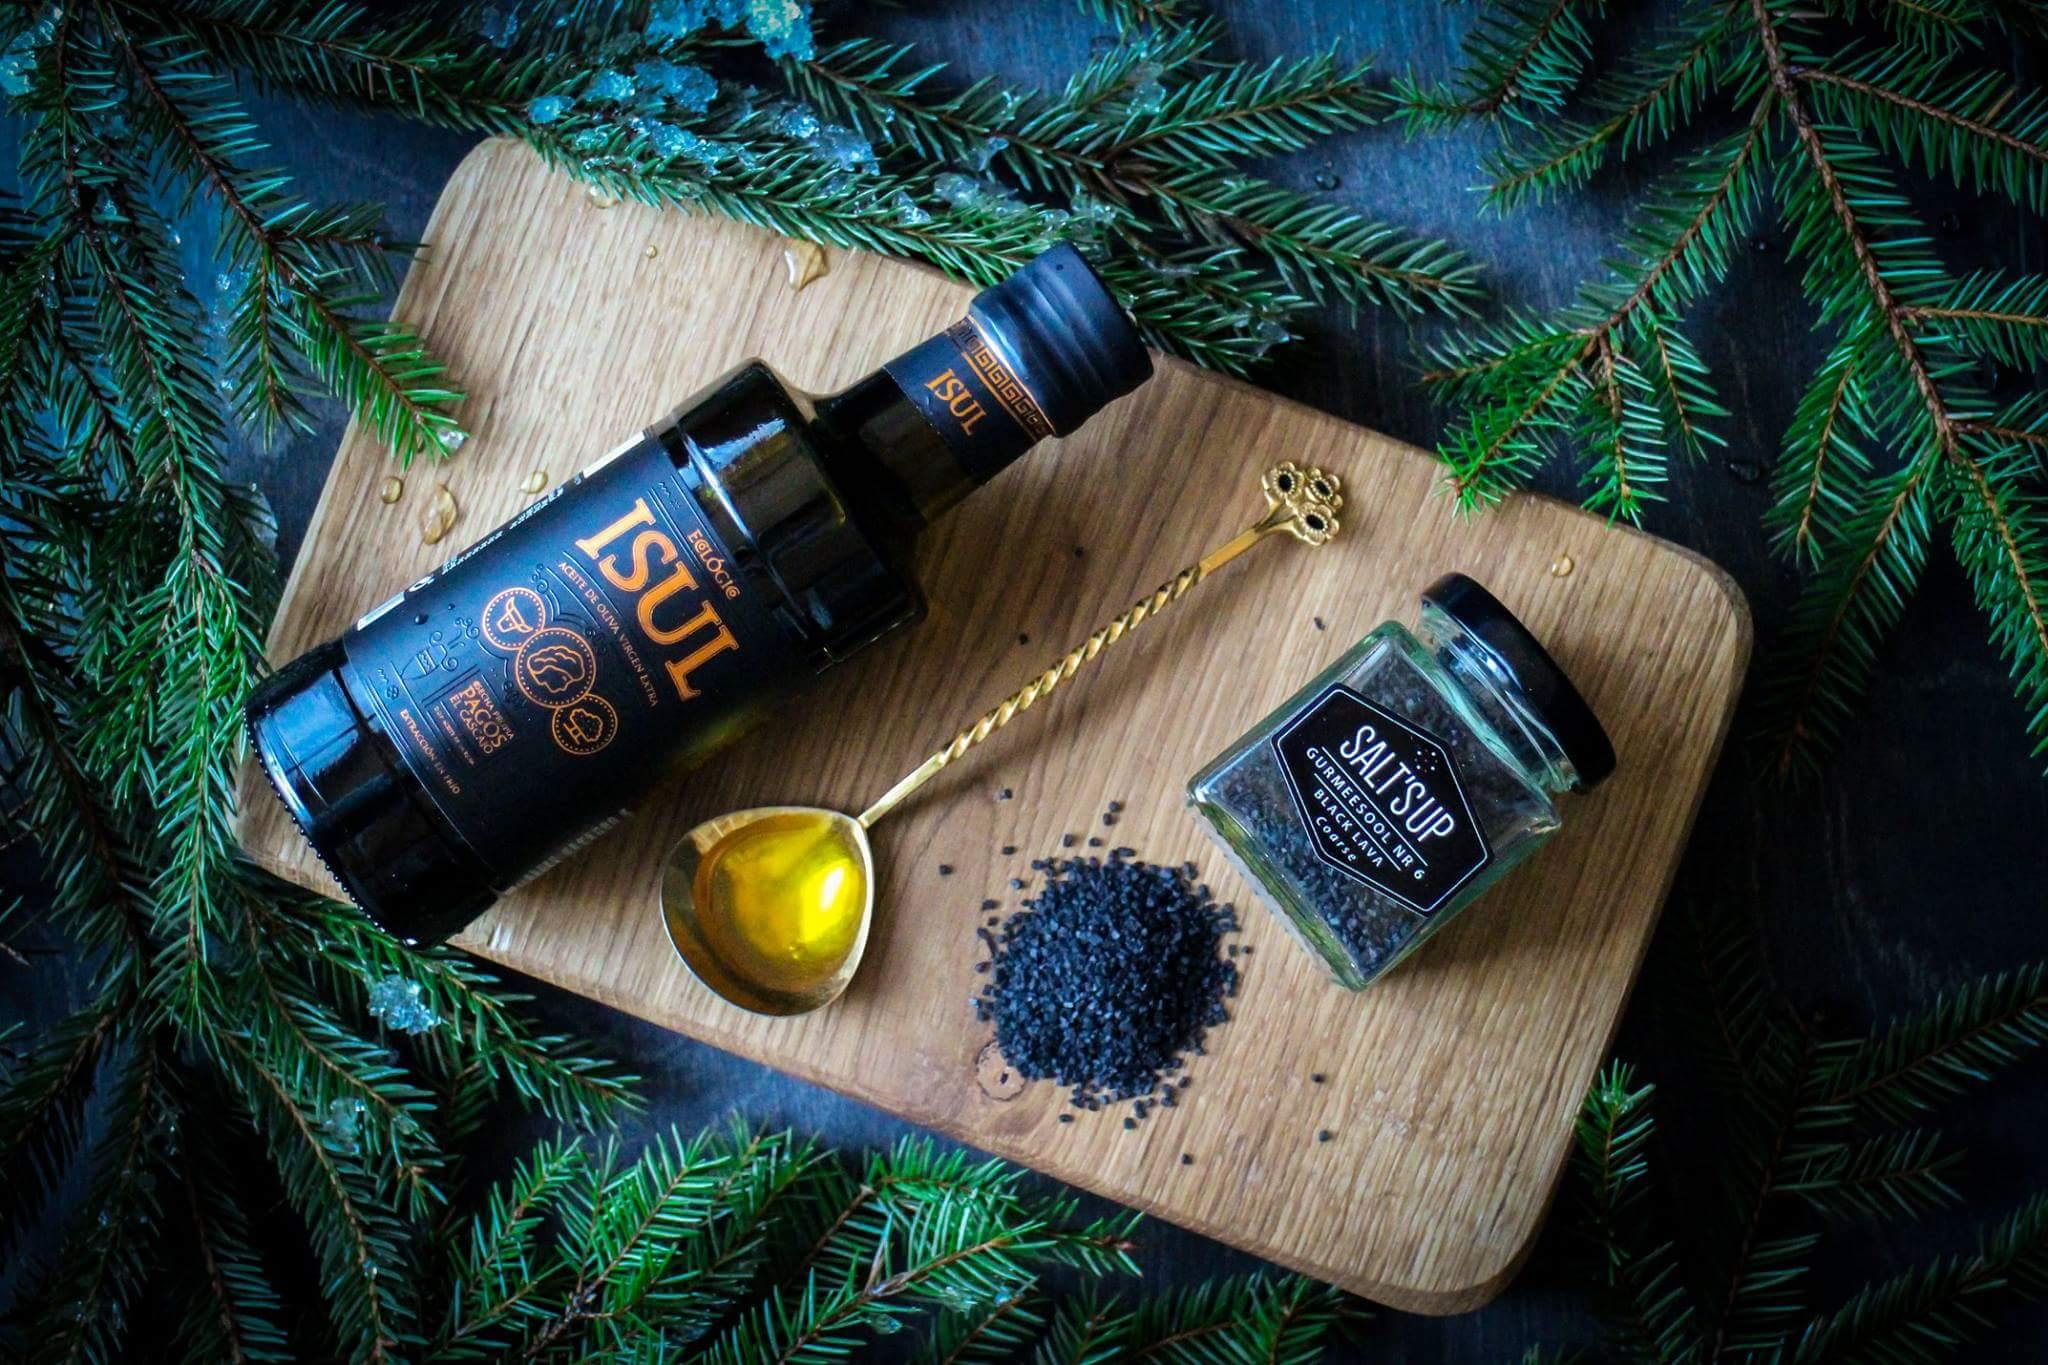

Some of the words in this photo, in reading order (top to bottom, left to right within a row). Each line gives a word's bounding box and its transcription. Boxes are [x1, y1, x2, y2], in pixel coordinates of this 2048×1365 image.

[924, 367, 987, 436] ISUL
[575, 497, 740, 700] ISUL
[558, 562, 586, 591] ACEITE
[585, 587, 598, 606] DE
[596, 603, 620, 635] OLIVA
[618, 632, 645, 676] VIRGEN
[640, 673, 659, 708] EXTRA
[400, 709, 435, 761] EXTRACCIÓN
[449, 694, 462, 709] EL
[459, 685, 507, 748] PAGOS
[1306, 747, 1393, 844] GURMEESOOL
[1392, 844, 1414, 868] NR
[1413, 869, 1425, 880] 6
[1313, 788, 1353, 832] BLACK
[1352, 831, 1384, 868] LAVA
[1315, 816, 1357, 862] Coarse
